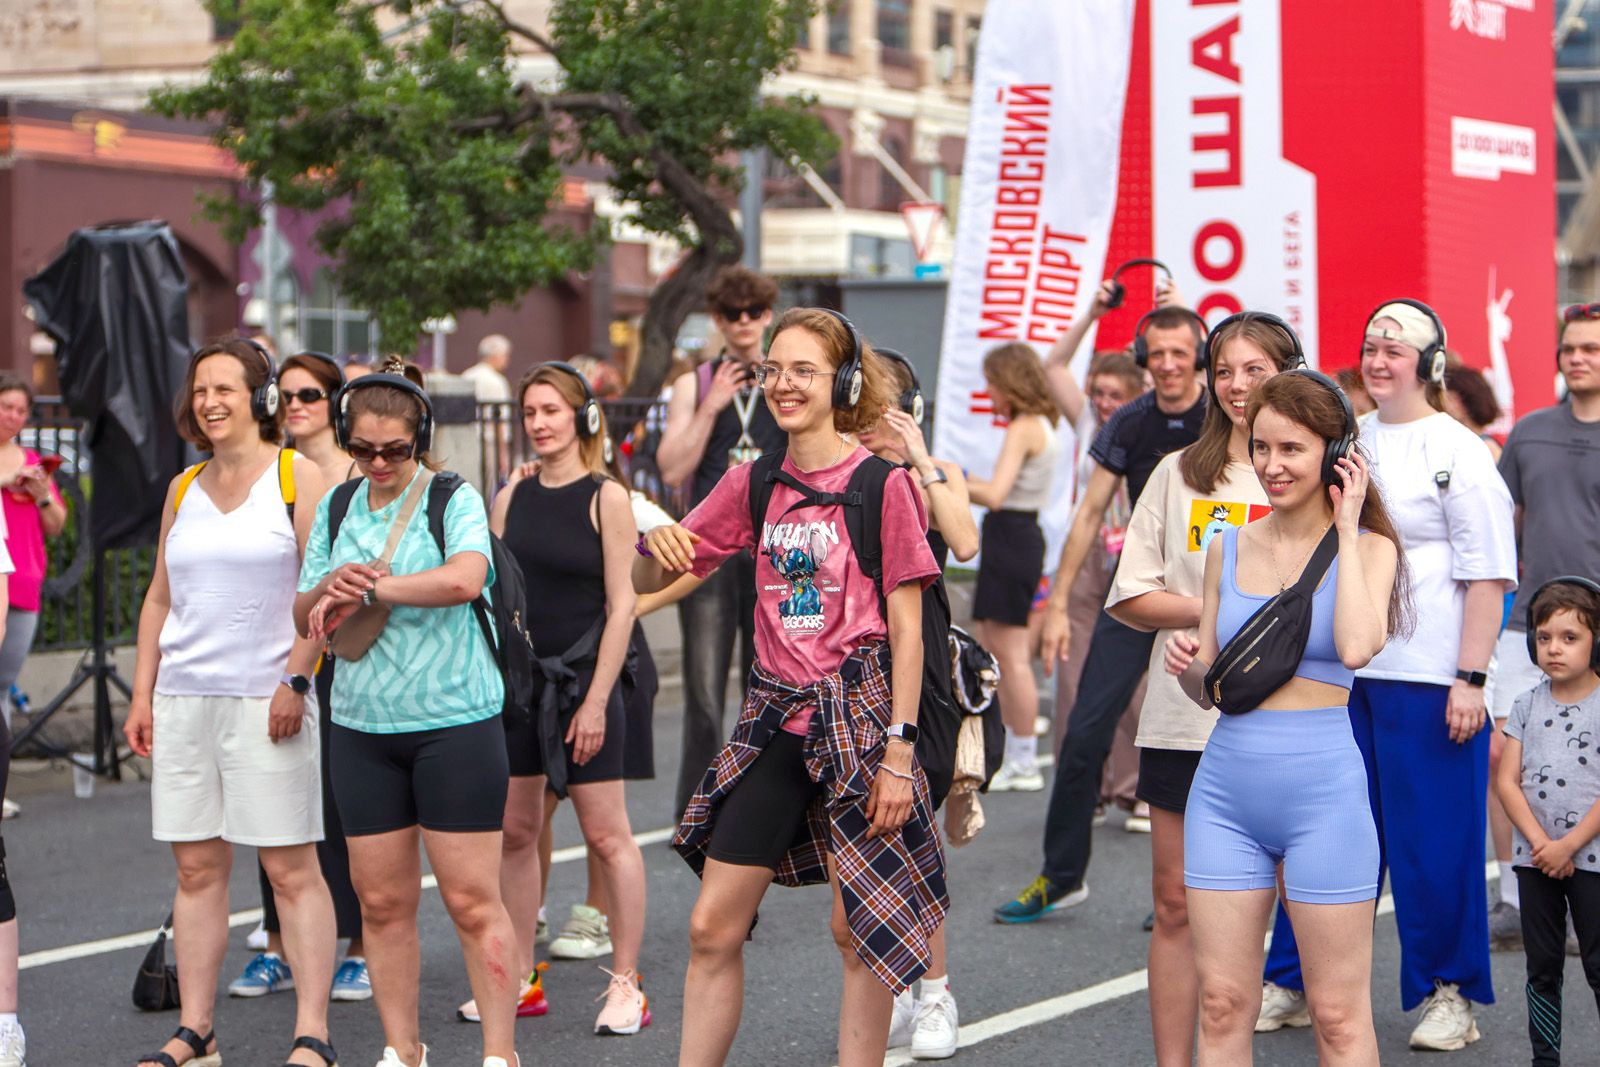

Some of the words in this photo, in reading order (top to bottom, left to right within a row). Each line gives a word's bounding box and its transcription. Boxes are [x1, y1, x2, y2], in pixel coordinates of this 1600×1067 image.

[1190, 0, 1242, 189] ША
[977, 84, 1053, 341] МОСКОВСКИЙ
[1026, 224, 1087, 344] СПОРТ
